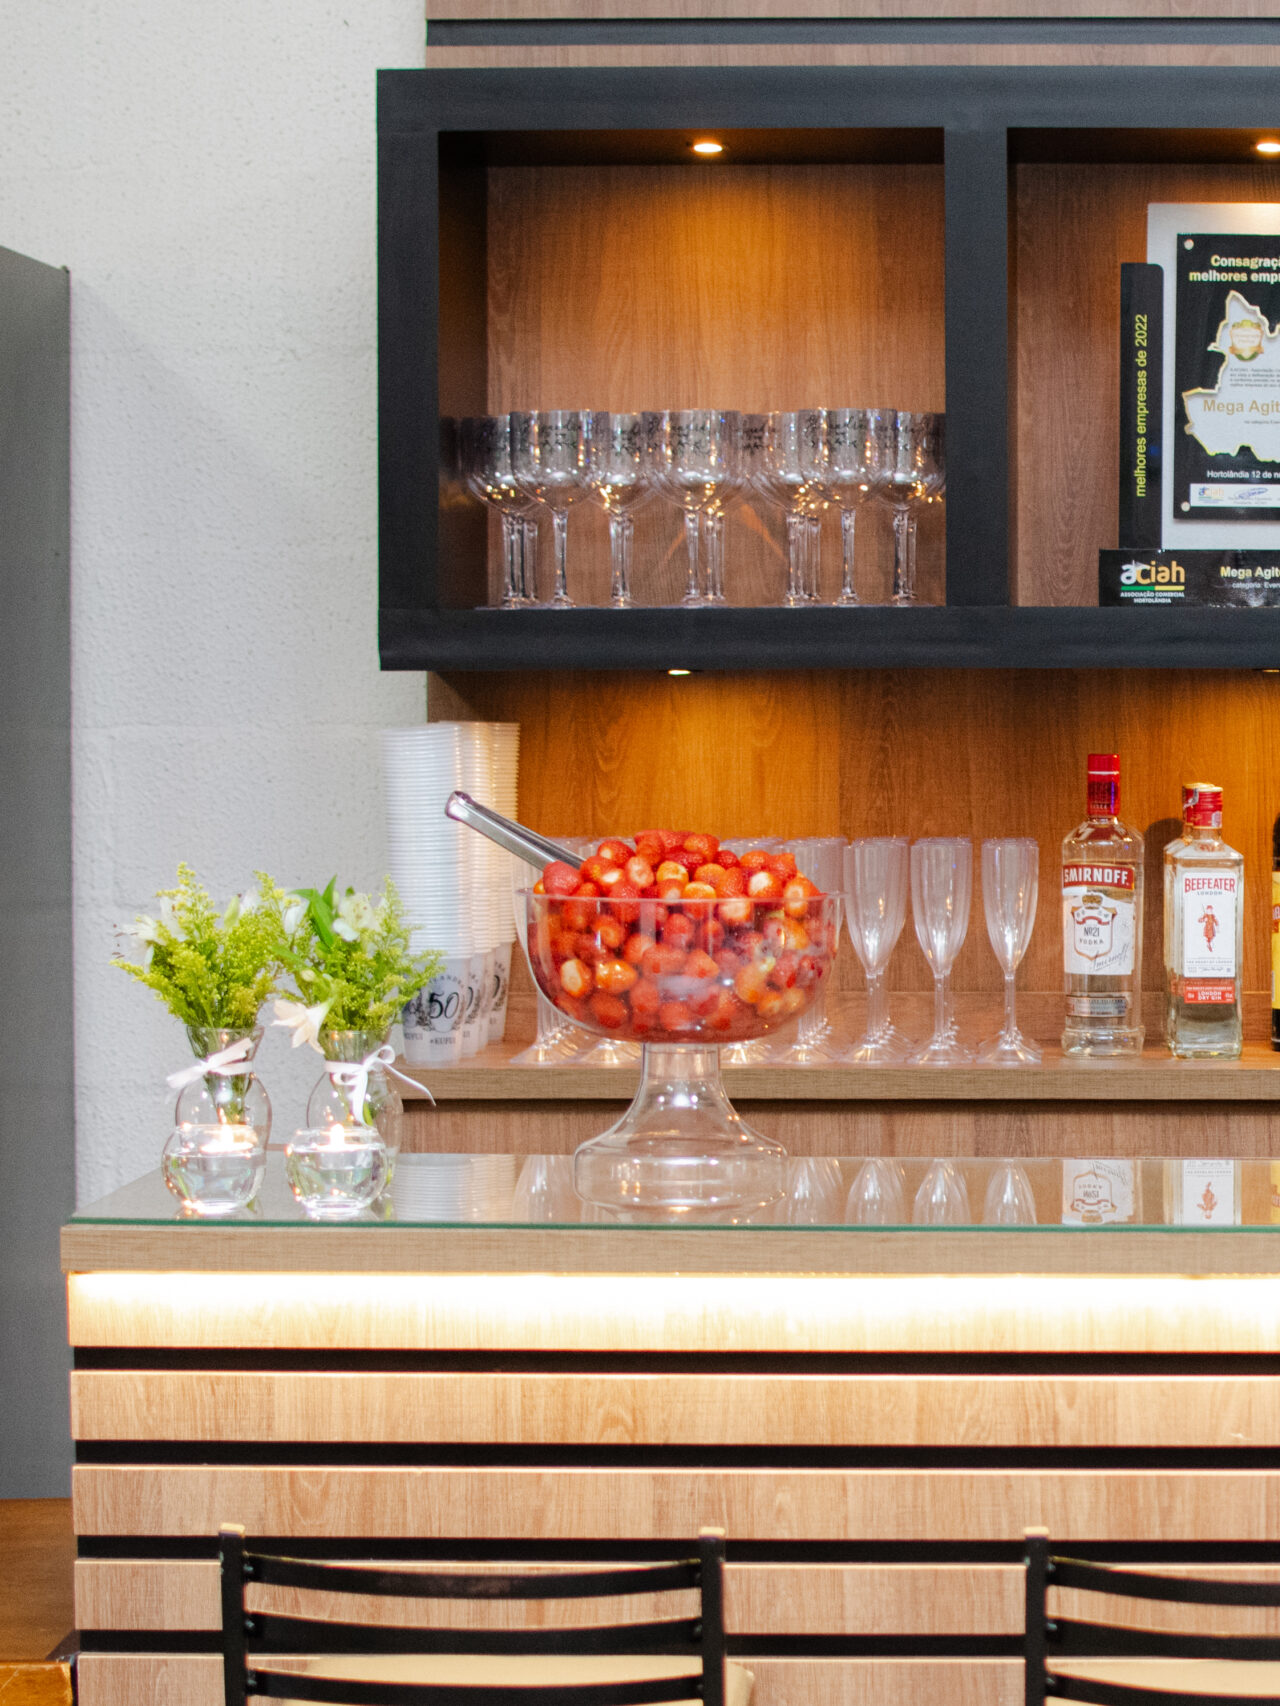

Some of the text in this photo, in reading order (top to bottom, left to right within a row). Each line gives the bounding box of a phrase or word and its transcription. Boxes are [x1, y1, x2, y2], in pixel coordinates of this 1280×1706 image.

[1189, 270, 1247, 282] melhores
[1134, 314, 1149, 497] melhores empresas de 2022
[1203, 400, 1244, 415] Mega
[1207, 470, 1249, 479] Hortolândia
[1251, 471, 1261, 479] 12
[1262, 471, 1272, 479] de
[1120, 560, 1185, 585] aciah
[1220, 566, 1252, 579] Mega
[1064, 867, 1128, 885] SMIRNOFF
[1184, 878, 1236, 893] BEEFEATER
[429, 991, 460, 1019] 50
